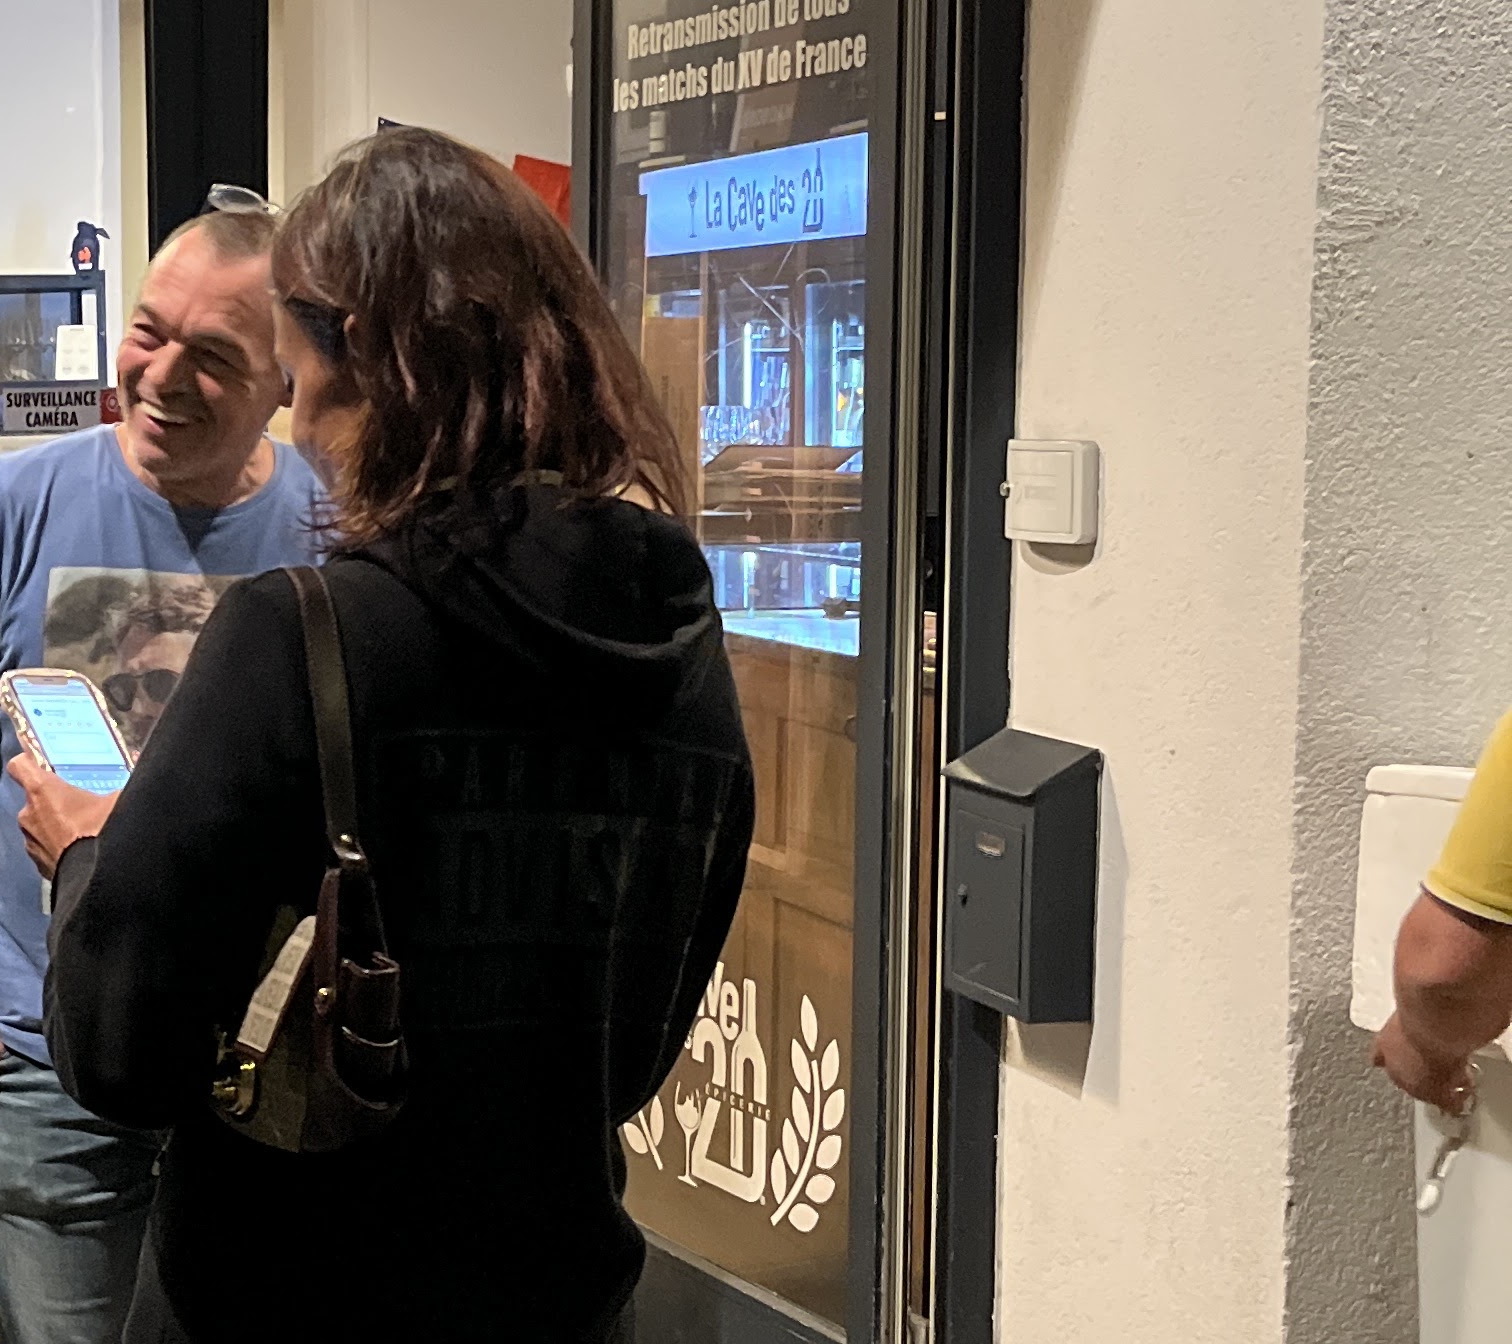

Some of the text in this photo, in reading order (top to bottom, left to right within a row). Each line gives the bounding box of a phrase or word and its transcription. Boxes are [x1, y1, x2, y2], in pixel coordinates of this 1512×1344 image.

[612, 32, 867, 113] les matchs du XV de France
[705, 180, 722, 229] La
[769, 174, 795, 224] des
[6, 390, 97, 408] SURVEILLANCE
[25, 406, 79, 428] CAMÉRA
